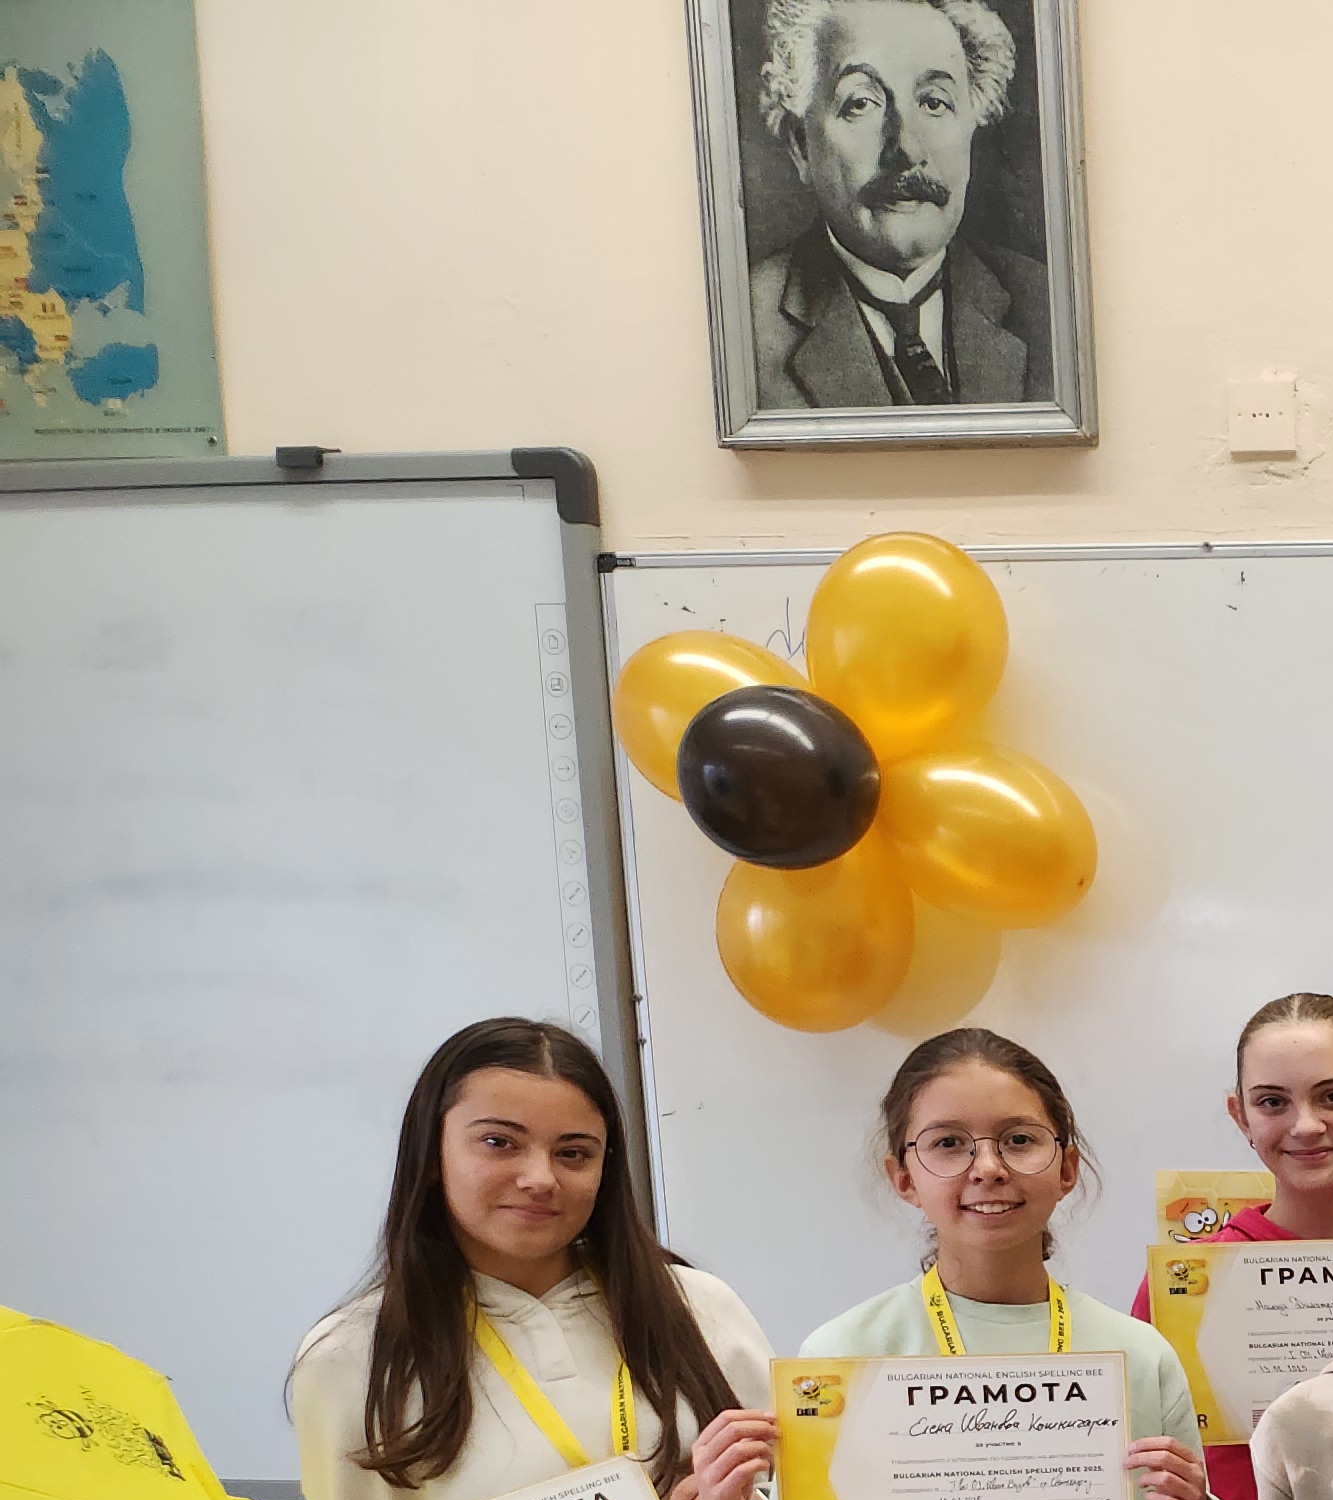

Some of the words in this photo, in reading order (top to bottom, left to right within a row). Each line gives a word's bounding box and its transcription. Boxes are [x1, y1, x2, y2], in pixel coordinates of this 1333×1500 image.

[887, 1373, 943, 1382] BULGARIAN
[945, 1371, 993, 1381] NATIONAL
[996, 1370, 1037, 1380] ENGLISH
[1038, 1369, 1083, 1379] SPELLING
[1085, 1368, 1104, 1377] BEE
[907, 1381, 1087, 1406] ГРАМОТА
